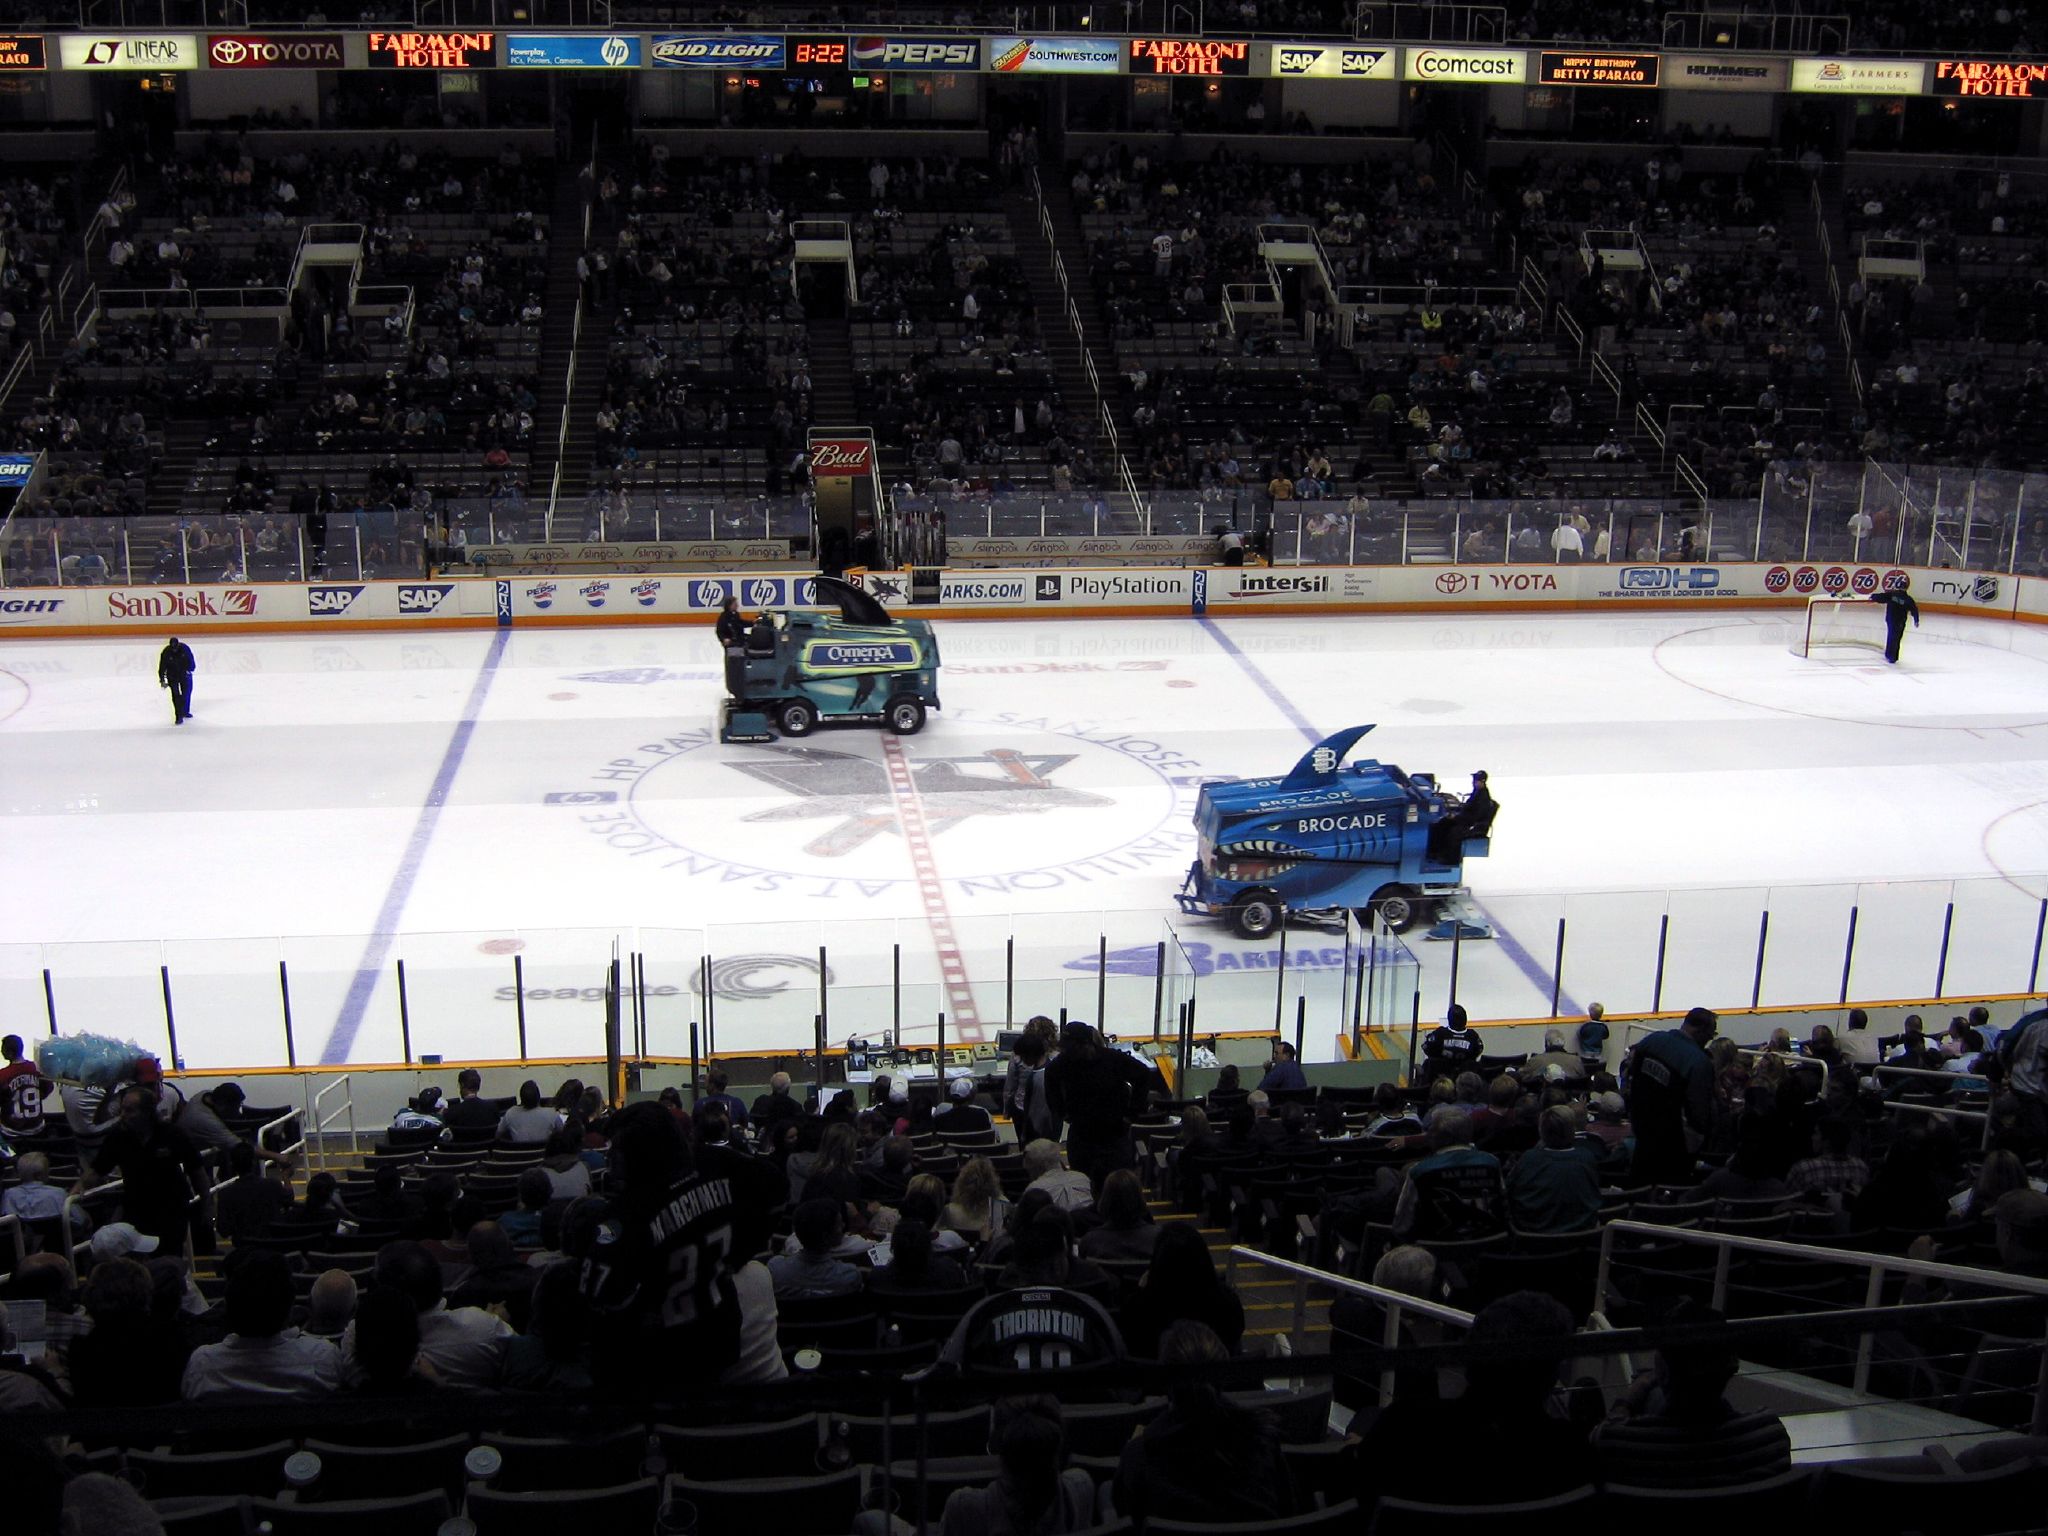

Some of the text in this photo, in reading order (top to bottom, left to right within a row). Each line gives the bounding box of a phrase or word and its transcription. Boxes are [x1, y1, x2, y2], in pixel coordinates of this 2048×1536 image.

[126, 41, 178, 59] LINEAR
[369, 33, 494, 51] FAIRMONT
[656, 44, 779, 57] BUD LIGHT
[1132, 39, 1248, 59] FAIRMONT
[249, 43, 340, 61] TOYOTA
[397, 49, 470, 68] HOTEL
[510, 47, 548, 58] Powerplay.
[796, 44, 845, 63] 8:22
[882, 43, 977, 64] PEPSI
[1029, 50, 1118, 62] SOUTHWEST.COM
[1155, 57, 1223, 74] HOTEL
[1280, 53, 1314, 70] SAP
[1342, 54, 1376, 71] SAP
[1563, 57, 1637, 68] HAPPY BIRTHDAY
[1553, 68, 1644, 81] BETTY SPARACO
[1687, 65, 1768, 77] HUMMER
[1852, 70, 1909, 79] FARMERS
[1937, 62, 2048, 81] FAIRMON
[1960, 79, 2033, 97] HOTEL
[811, 445, 868, 466] Bud
[978, 543, 1018, 554] slingbox
[1033, 543, 1070, 553] slingbox
[1083, 542, 1122, 552] slingbox
[1135, 542, 1174, 552] slingbox
[1188, 541, 1217, 551] slingb
[1242, 574, 1329, 593] intersil
[1627, 567, 1720, 589] FSN HD
[1767, 572, 1788, 587] 76
[1796, 572, 1817, 587] 76
[1825, 573, 1846, 588] 76
[1854, 573, 1876, 589] 76
[526, 585, 557, 597] PEPSI
[579, 583, 610, 596] PEPSI
[630, 581, 661, 594] PEPSI
[700, 580, 721, 607] hp
[753, 579, 774, 606] hp
[1071, 576, 1182, 600] PlayStation
[1932, 581, 1996, 600] my NHL
[108, 590, 218, 618] SanDisk
[310, 590, 352, 611] SAP
[399, 589, 442, 610] SAP
[1096, 735, 1202, 770] JOSE
[1259, 791, 1352, 807] BROCADE
[1298, 813, 1387, 833] BROCADE
[11, 1088, 41, 1119] 19
[650, 1176, 734, 1247] MARCHMENT
[991, 1308, 1086, 1343] THORNTON
